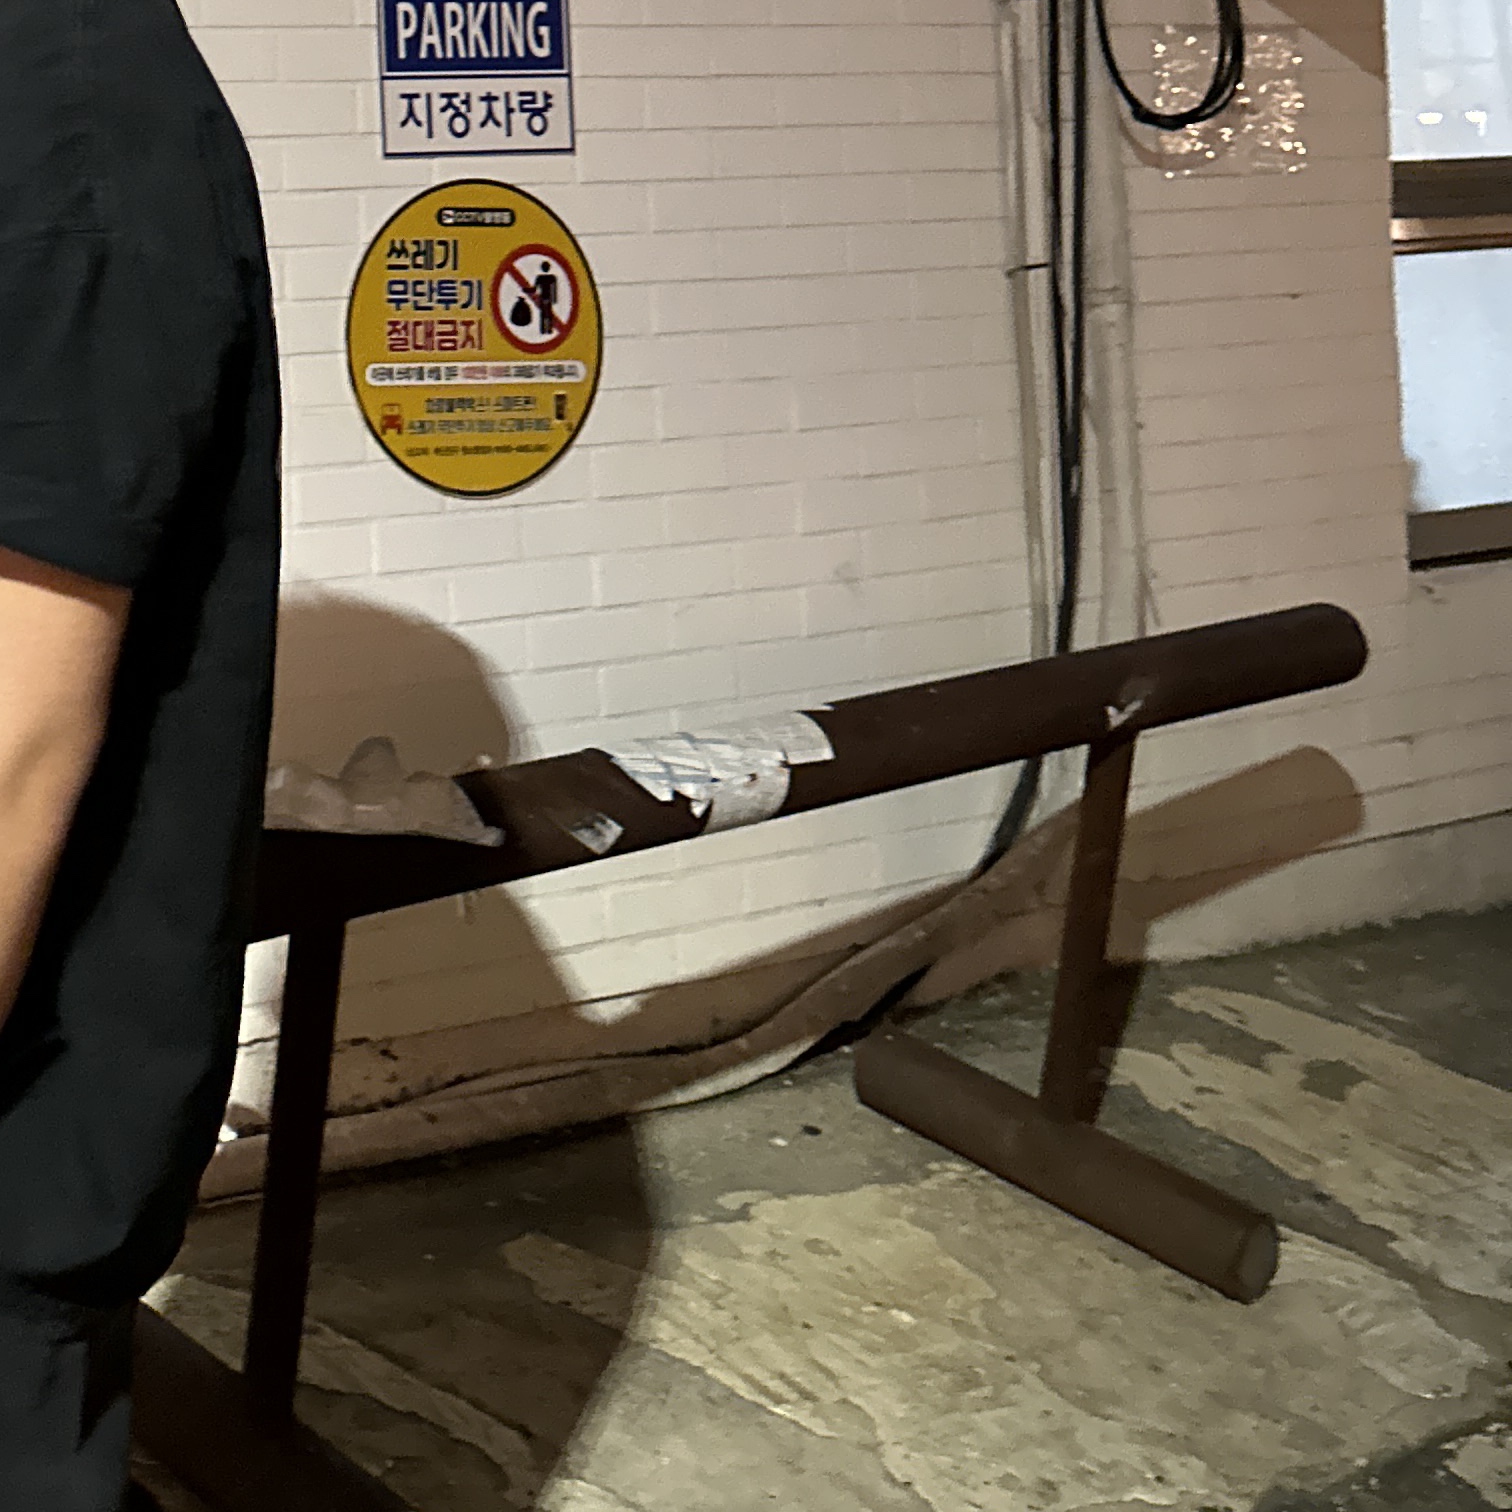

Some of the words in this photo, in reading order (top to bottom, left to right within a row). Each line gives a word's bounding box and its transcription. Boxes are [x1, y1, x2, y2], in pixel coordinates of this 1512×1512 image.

[395, 0, 552, 61] PARKING
[399, 90, 555, 140] 지정차량
[385, 237, 459, 272] 쓰레기
[385, 278, 484, 313] 무단투기
[386, 318, 484, 353] 절대금지
